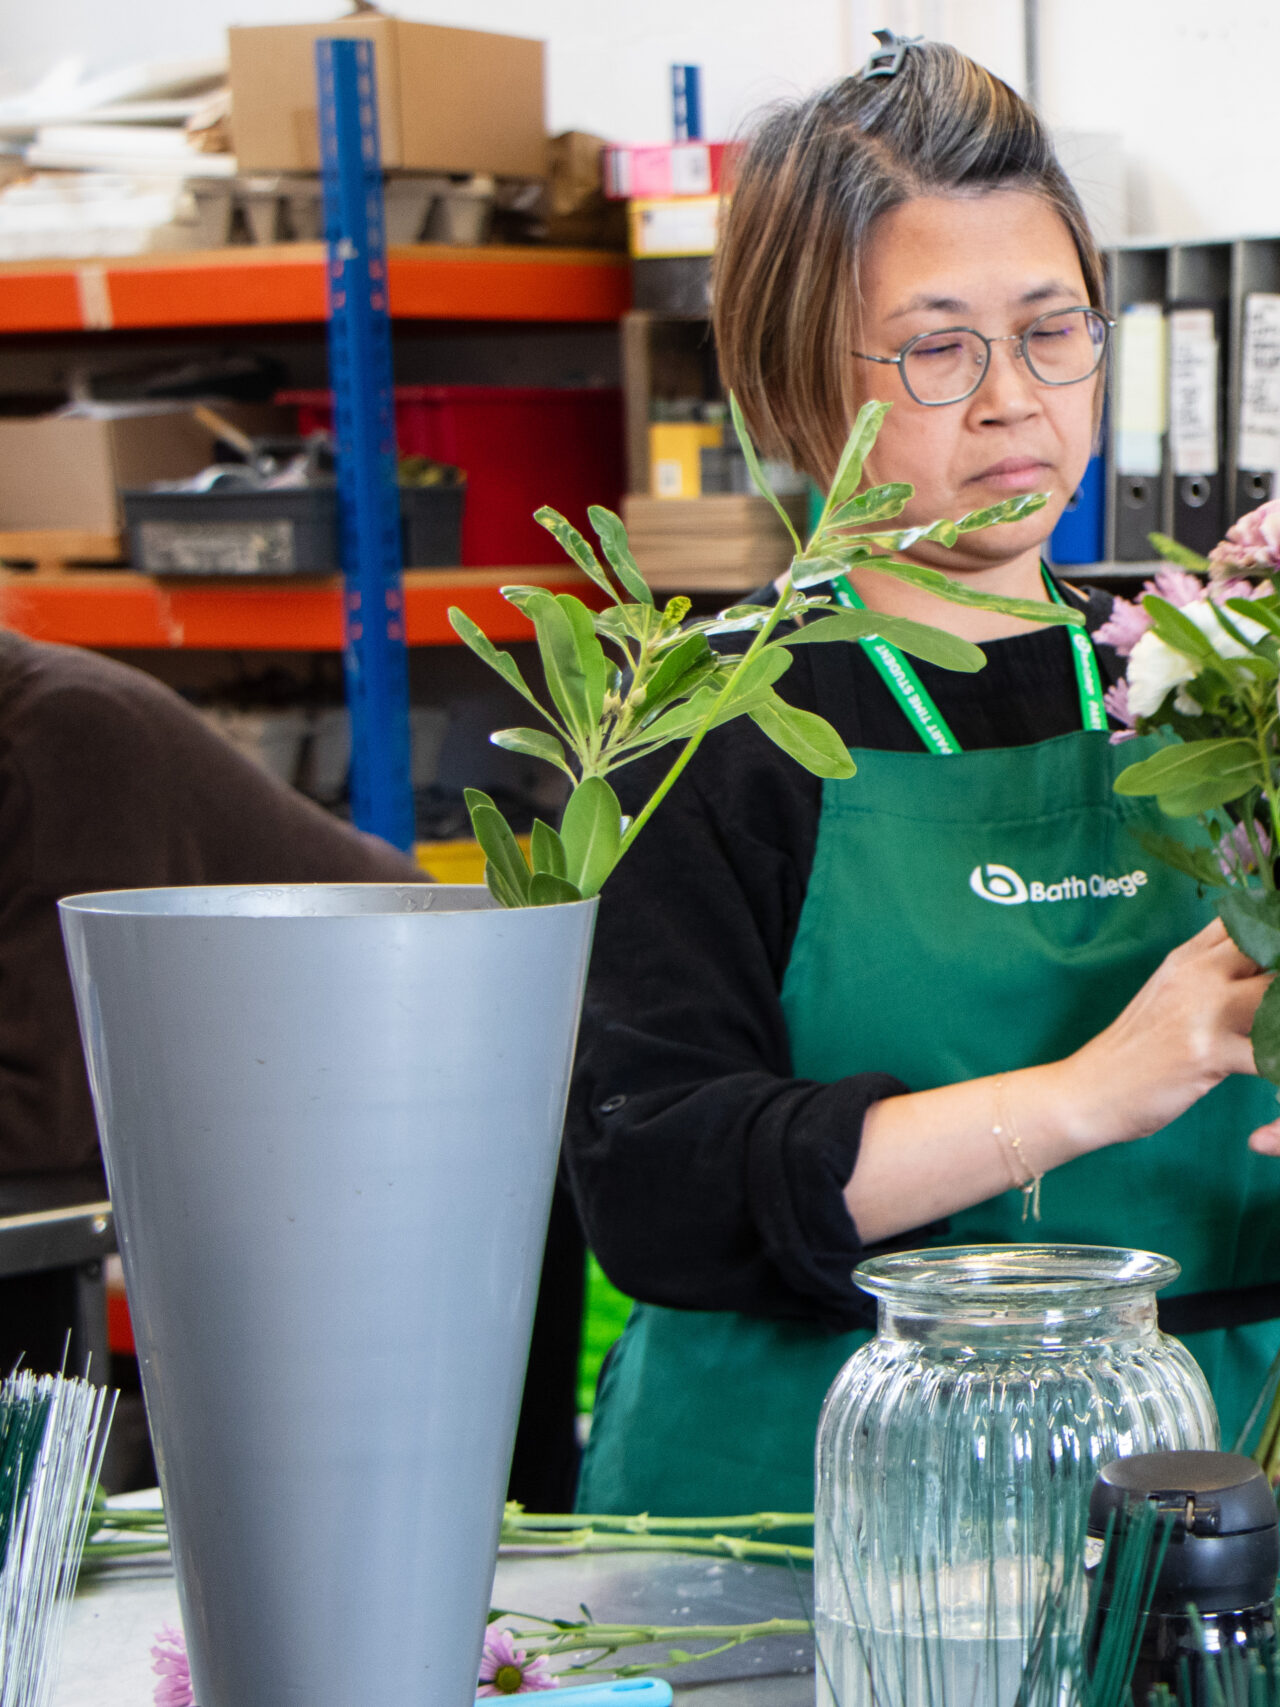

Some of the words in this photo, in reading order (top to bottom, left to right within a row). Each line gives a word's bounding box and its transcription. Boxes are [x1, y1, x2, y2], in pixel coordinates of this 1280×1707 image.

[873, 644, 915, 696] STUDENT
[907, 693, 932, 724] TIME
[1030, 875, 1087, 903] Bath
[1089, 869, 1149, 898] Clege
